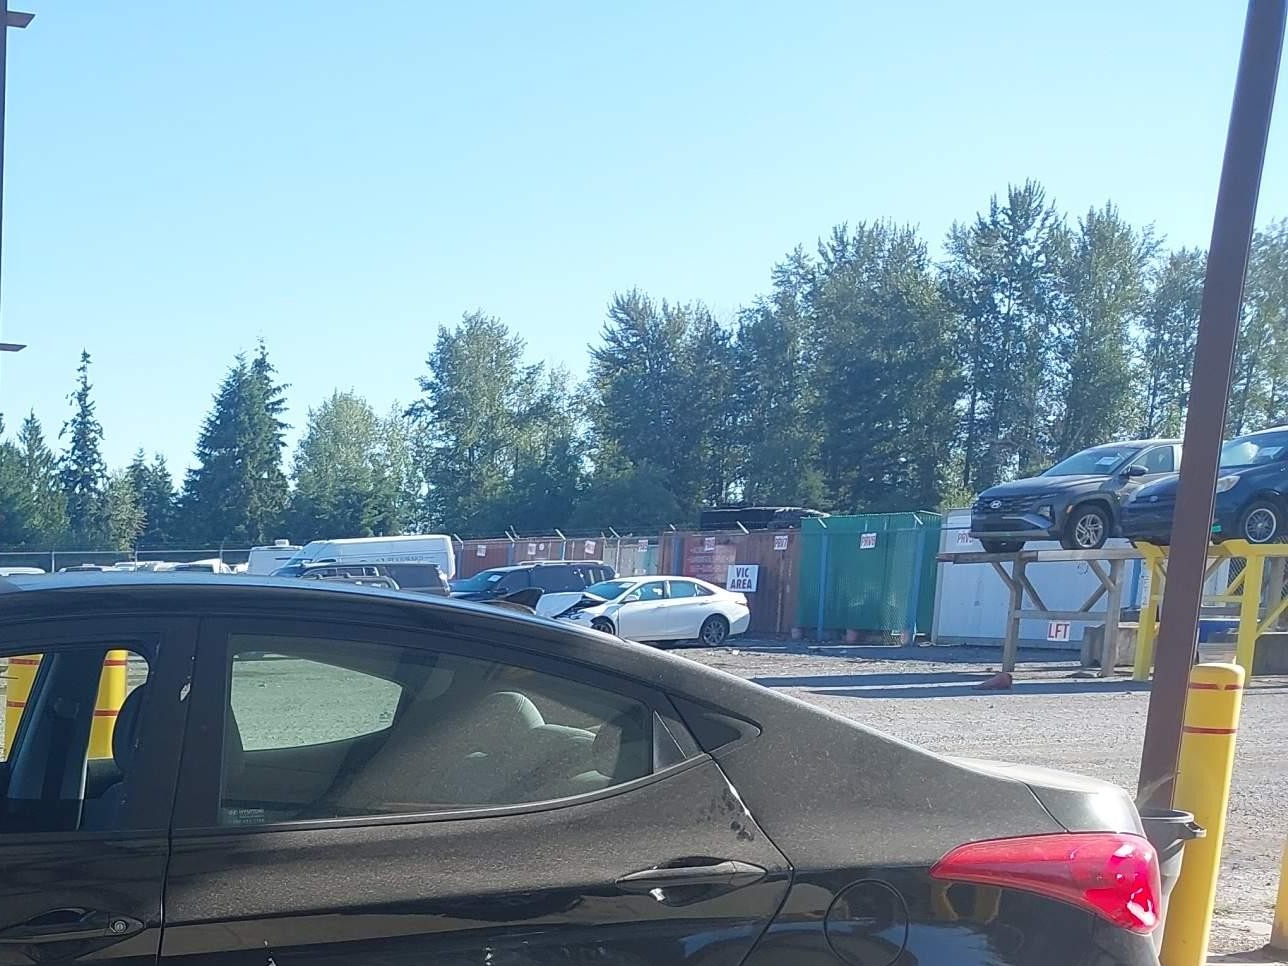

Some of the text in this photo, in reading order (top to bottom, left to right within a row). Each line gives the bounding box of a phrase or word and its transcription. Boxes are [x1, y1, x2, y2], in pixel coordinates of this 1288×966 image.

[735, 567, 750, 578] VIC
[730, 578, 752, 590] AREA
[1048, 623, 1070, 639] LFT
